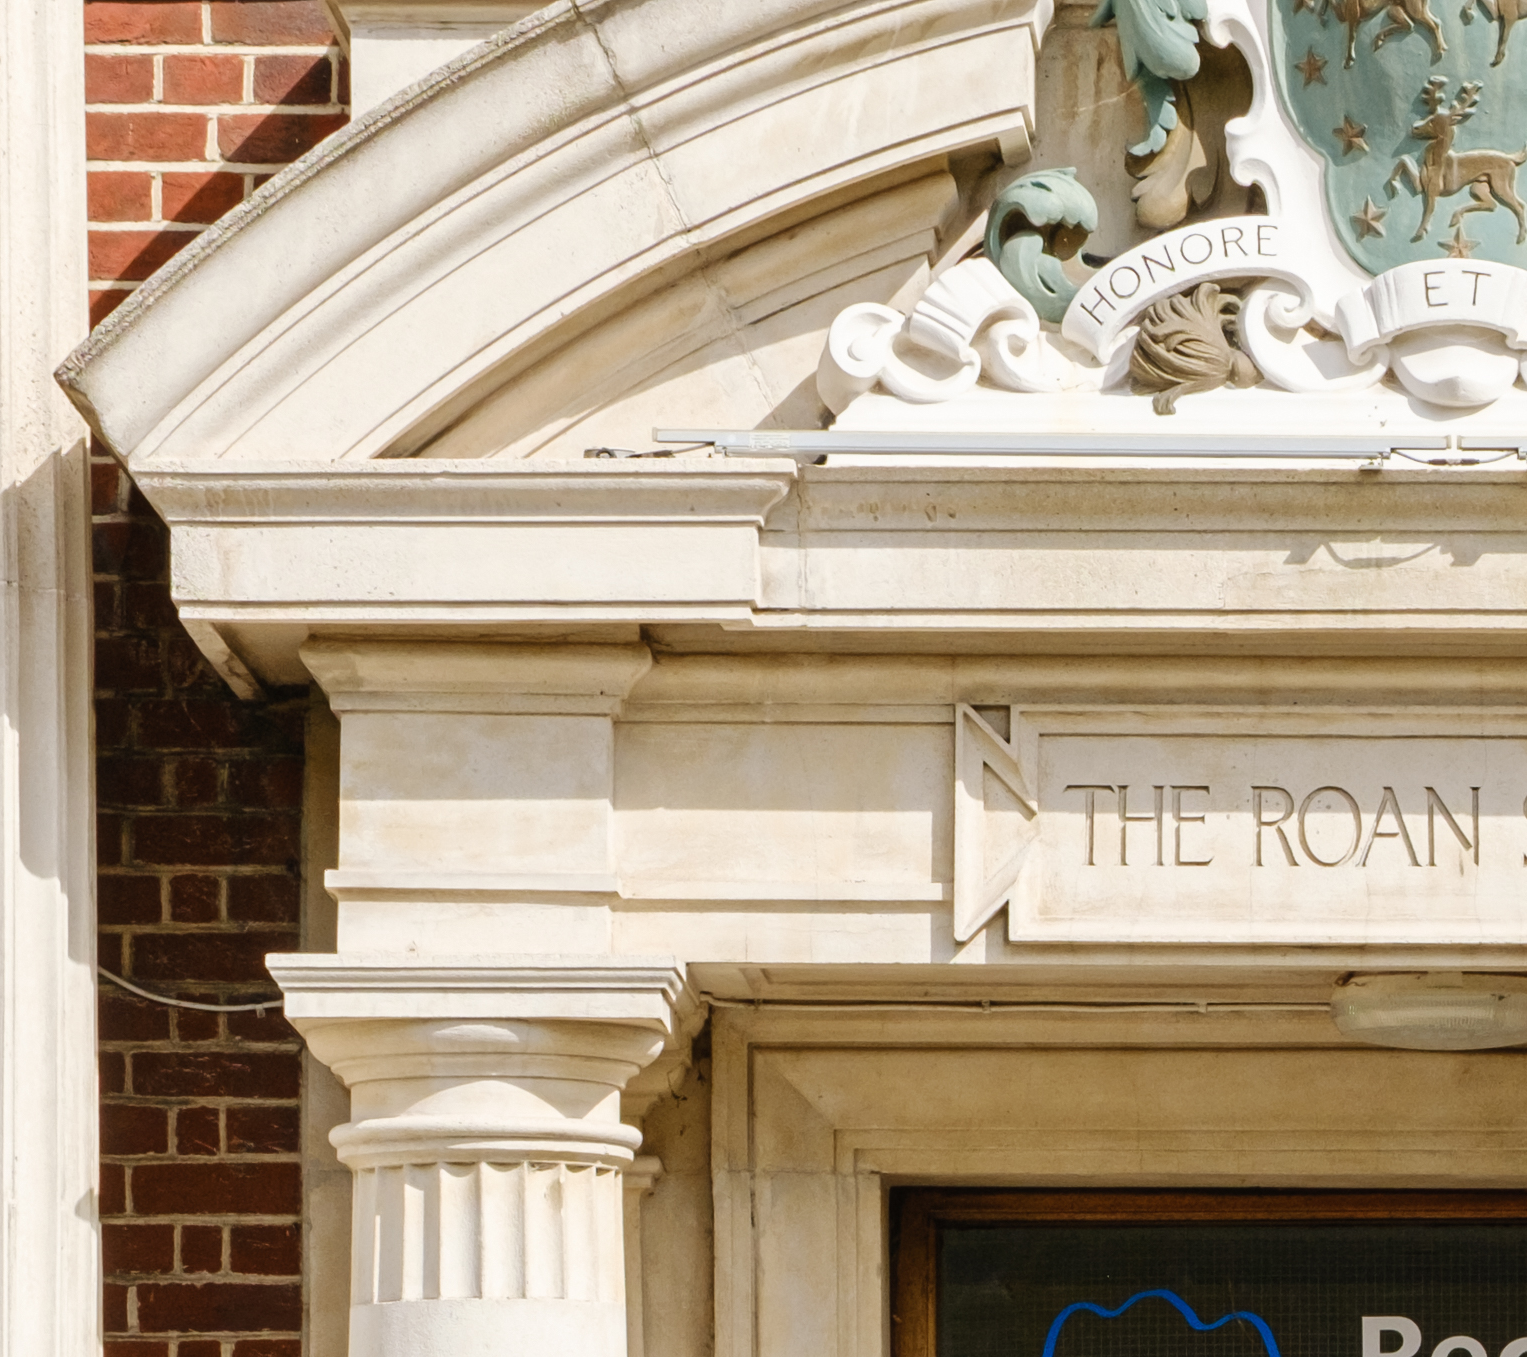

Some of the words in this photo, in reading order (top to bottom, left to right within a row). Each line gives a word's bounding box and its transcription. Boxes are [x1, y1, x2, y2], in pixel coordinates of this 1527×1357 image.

[1081, 225, 1278, 325] HONORE
[1423, 269, 1492, 308] ET
[1063, 784, 1215, 867] THE
[1250, 785, 1480, 868] ROAN
